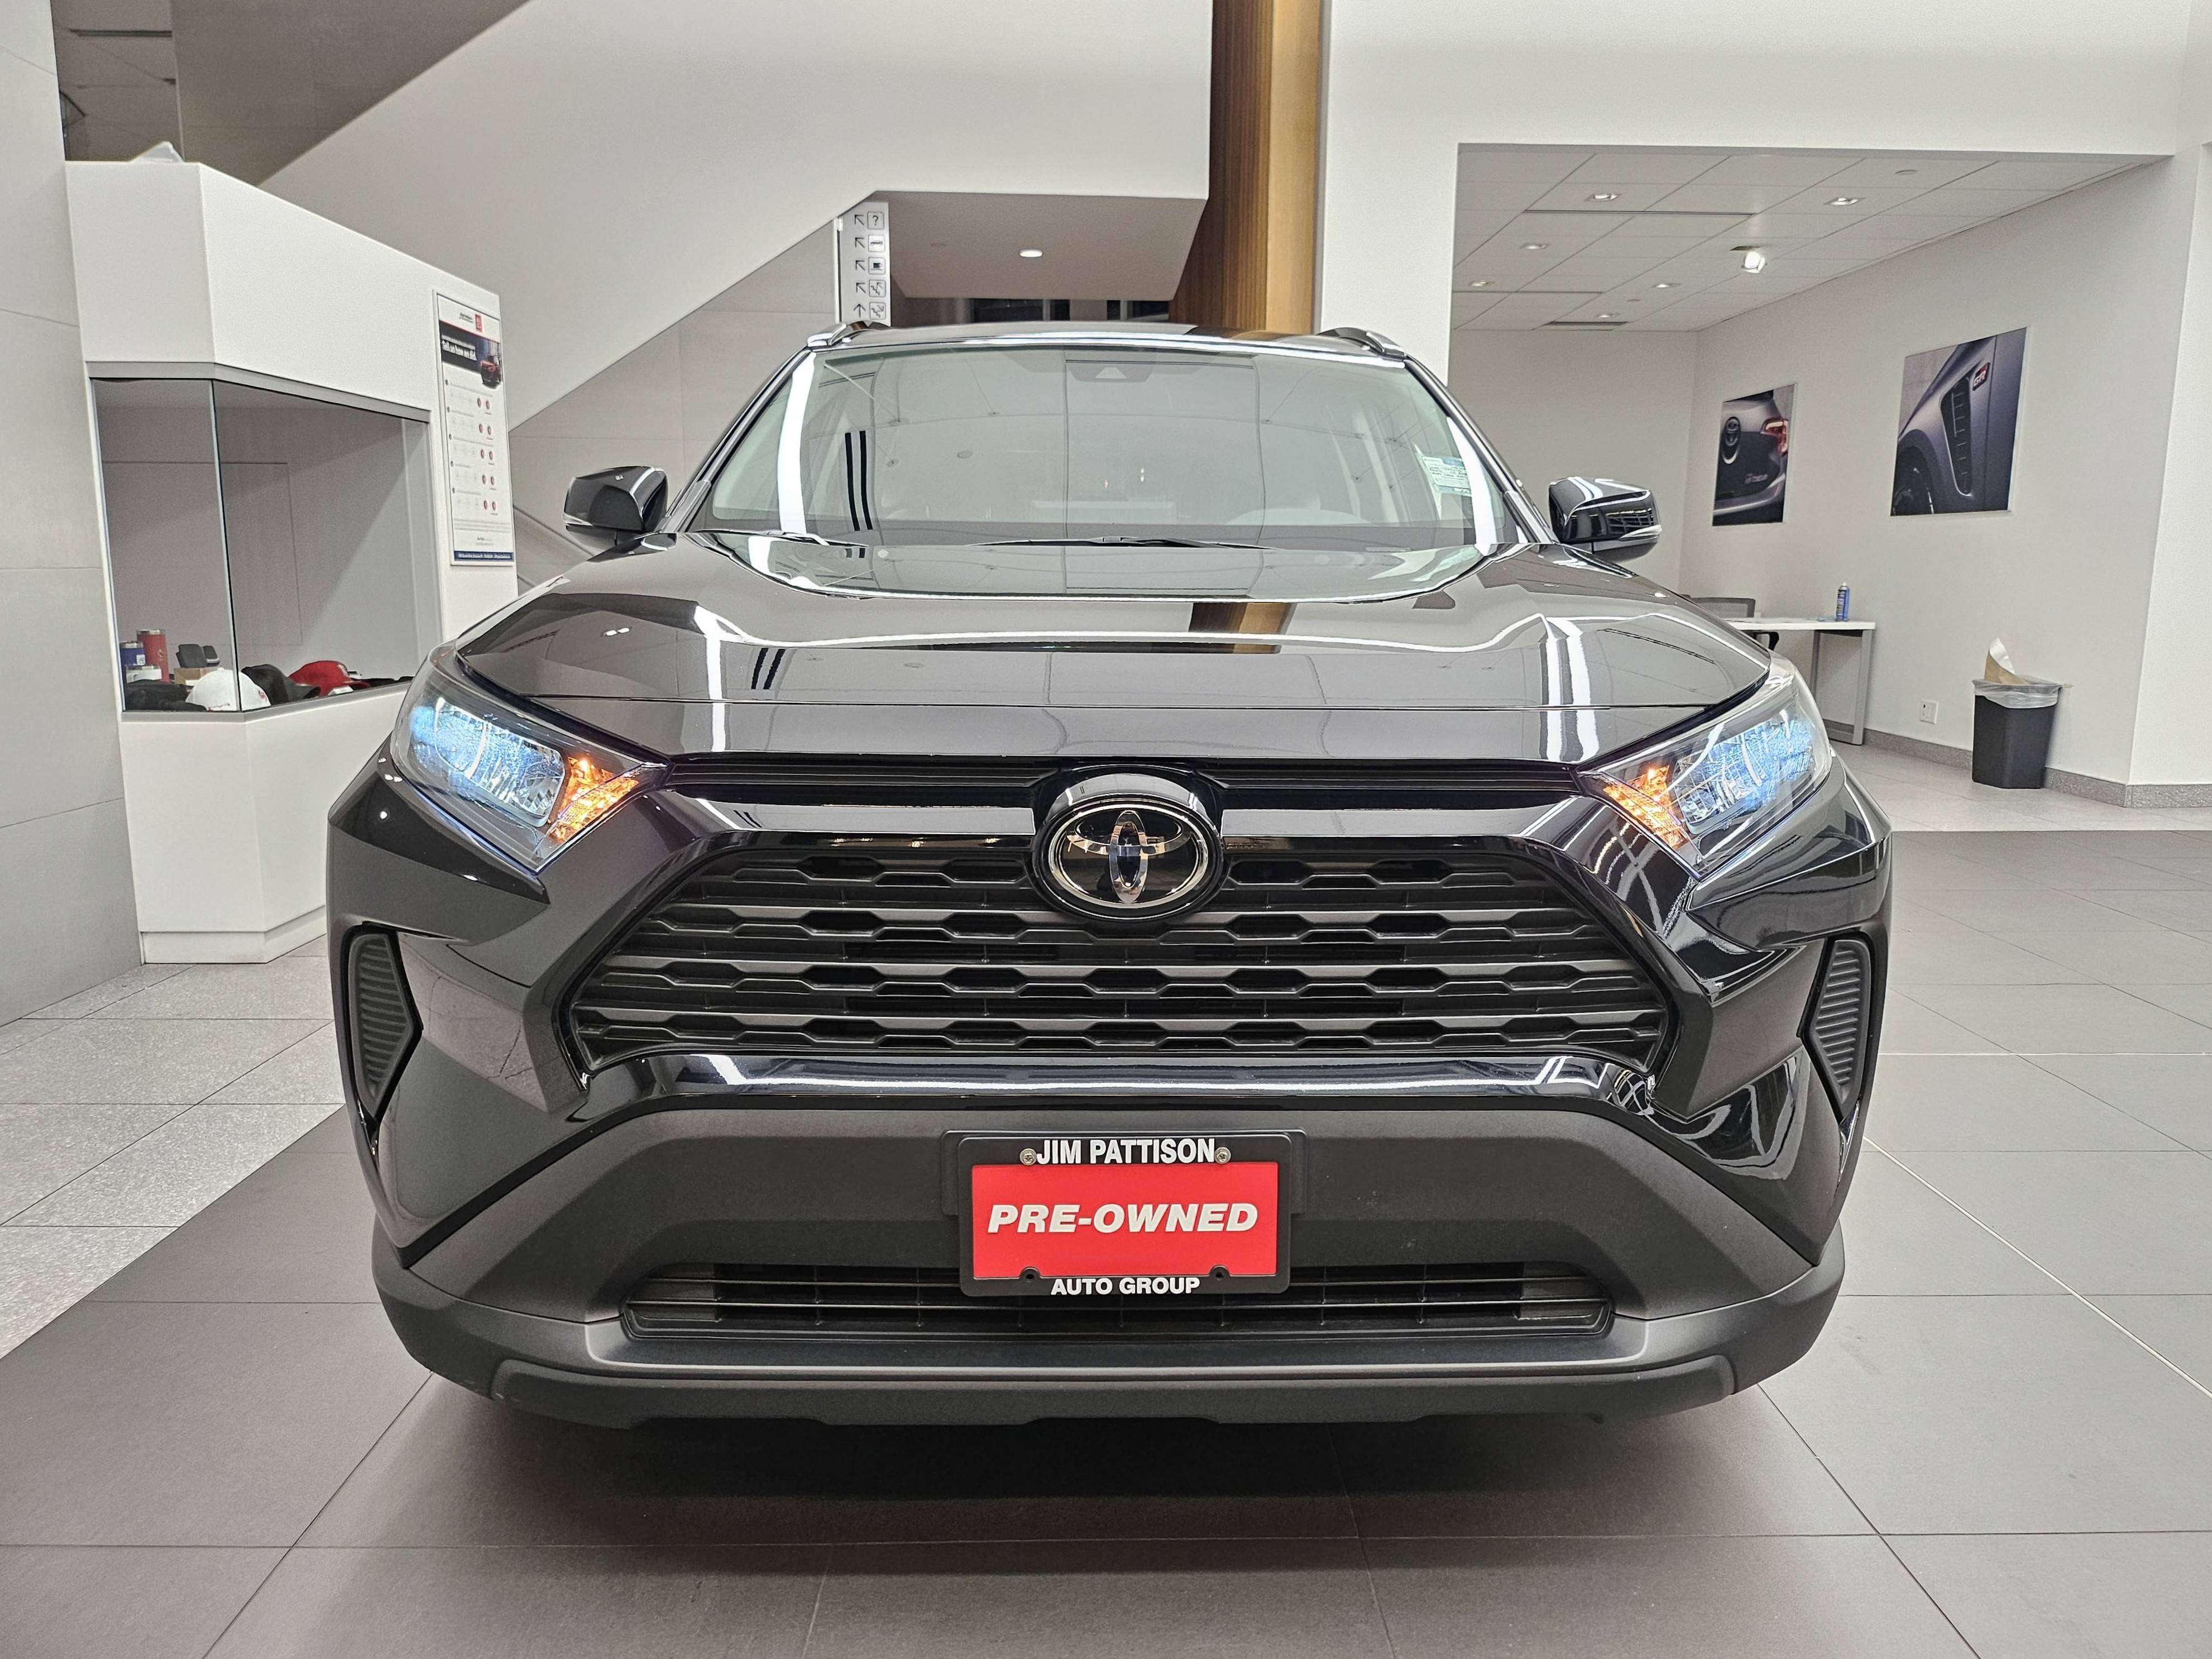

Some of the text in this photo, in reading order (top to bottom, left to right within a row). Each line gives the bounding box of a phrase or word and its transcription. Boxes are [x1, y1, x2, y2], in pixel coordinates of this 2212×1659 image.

[1037, 1138, 1215, 1164] JIM PATTISON
[987, 1203, 1258, 1234] PRE-OWNED
[1051, 1277, 1200, 1295] AUTO GROUP
